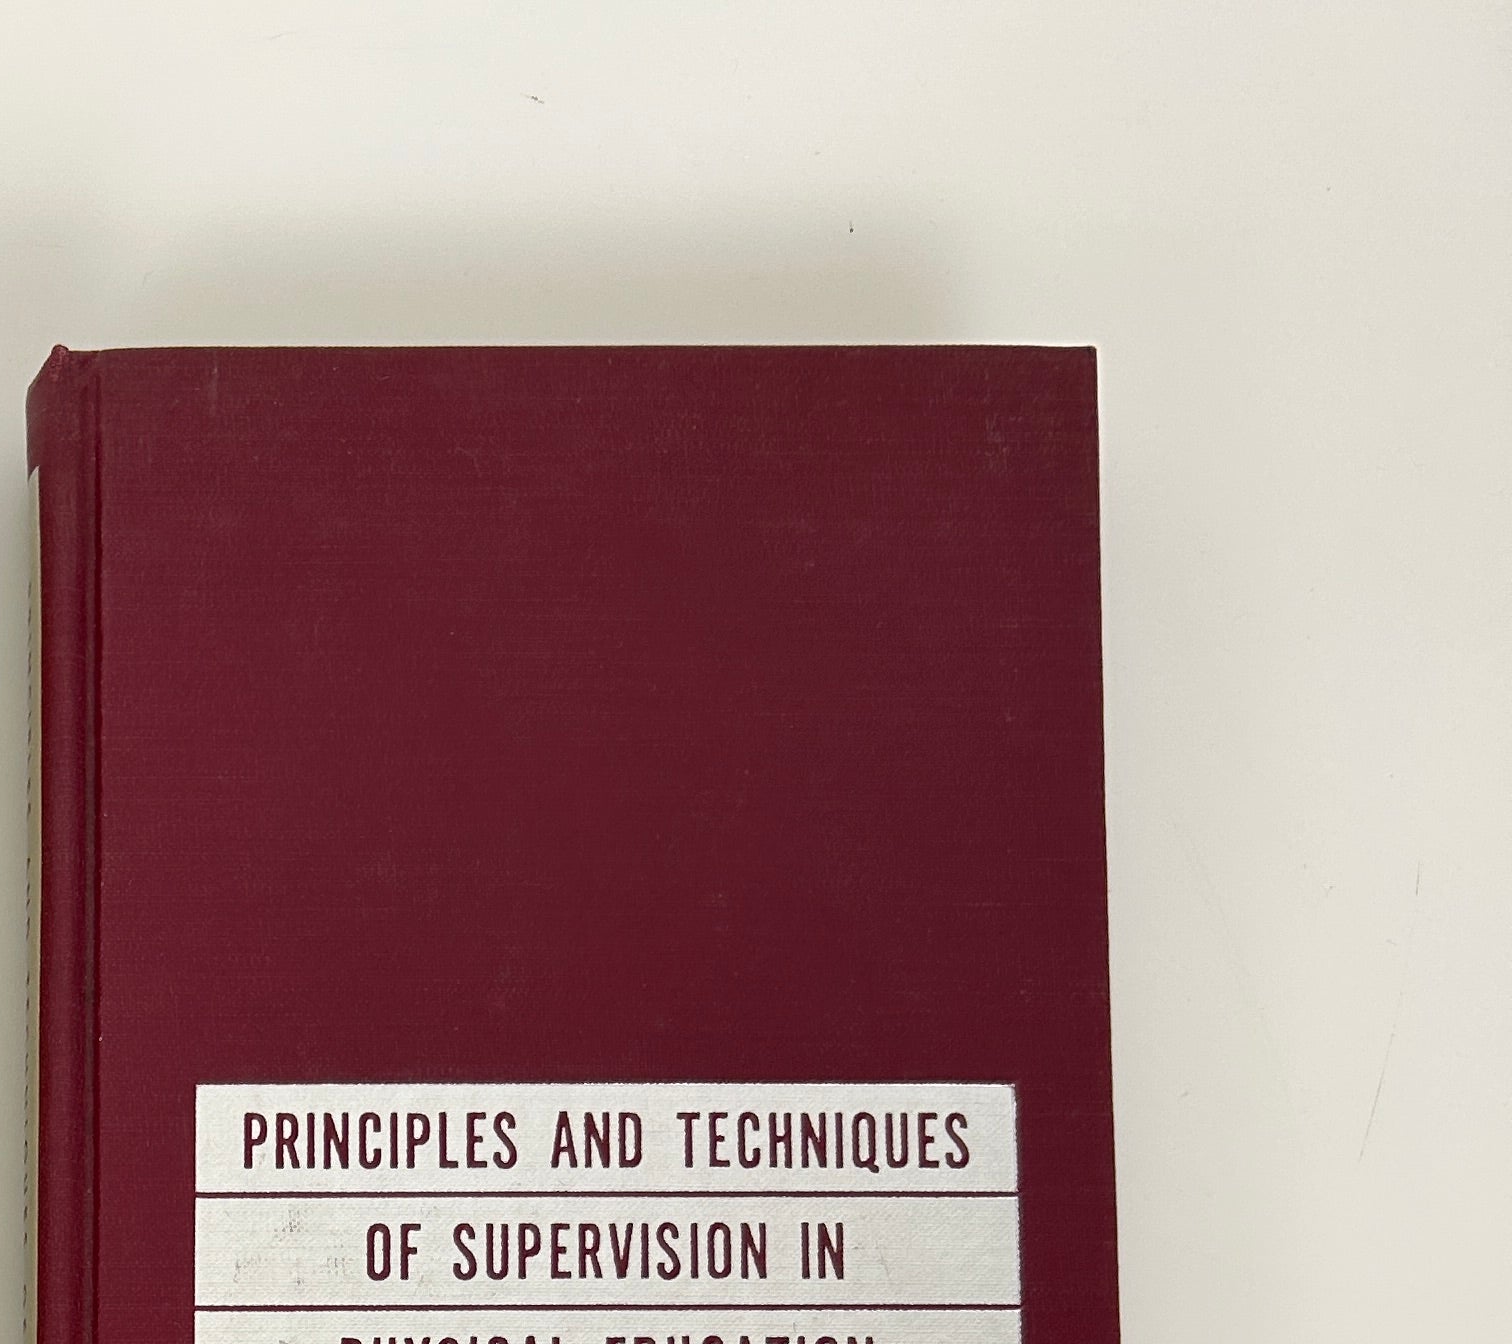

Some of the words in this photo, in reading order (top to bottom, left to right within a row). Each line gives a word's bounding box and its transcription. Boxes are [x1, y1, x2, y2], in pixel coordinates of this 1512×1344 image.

[244, 1111, 518, 1170] PRINCIPLES
[552, 1111, 643, 1169] AND
[683, 1111, 970, 1173] TECHNIQUES
[366, 1223, 422, 1281] OF
[453, 1222, 768, 1281] SUPERVISION
[801, 1223, 846, 1280] IN
